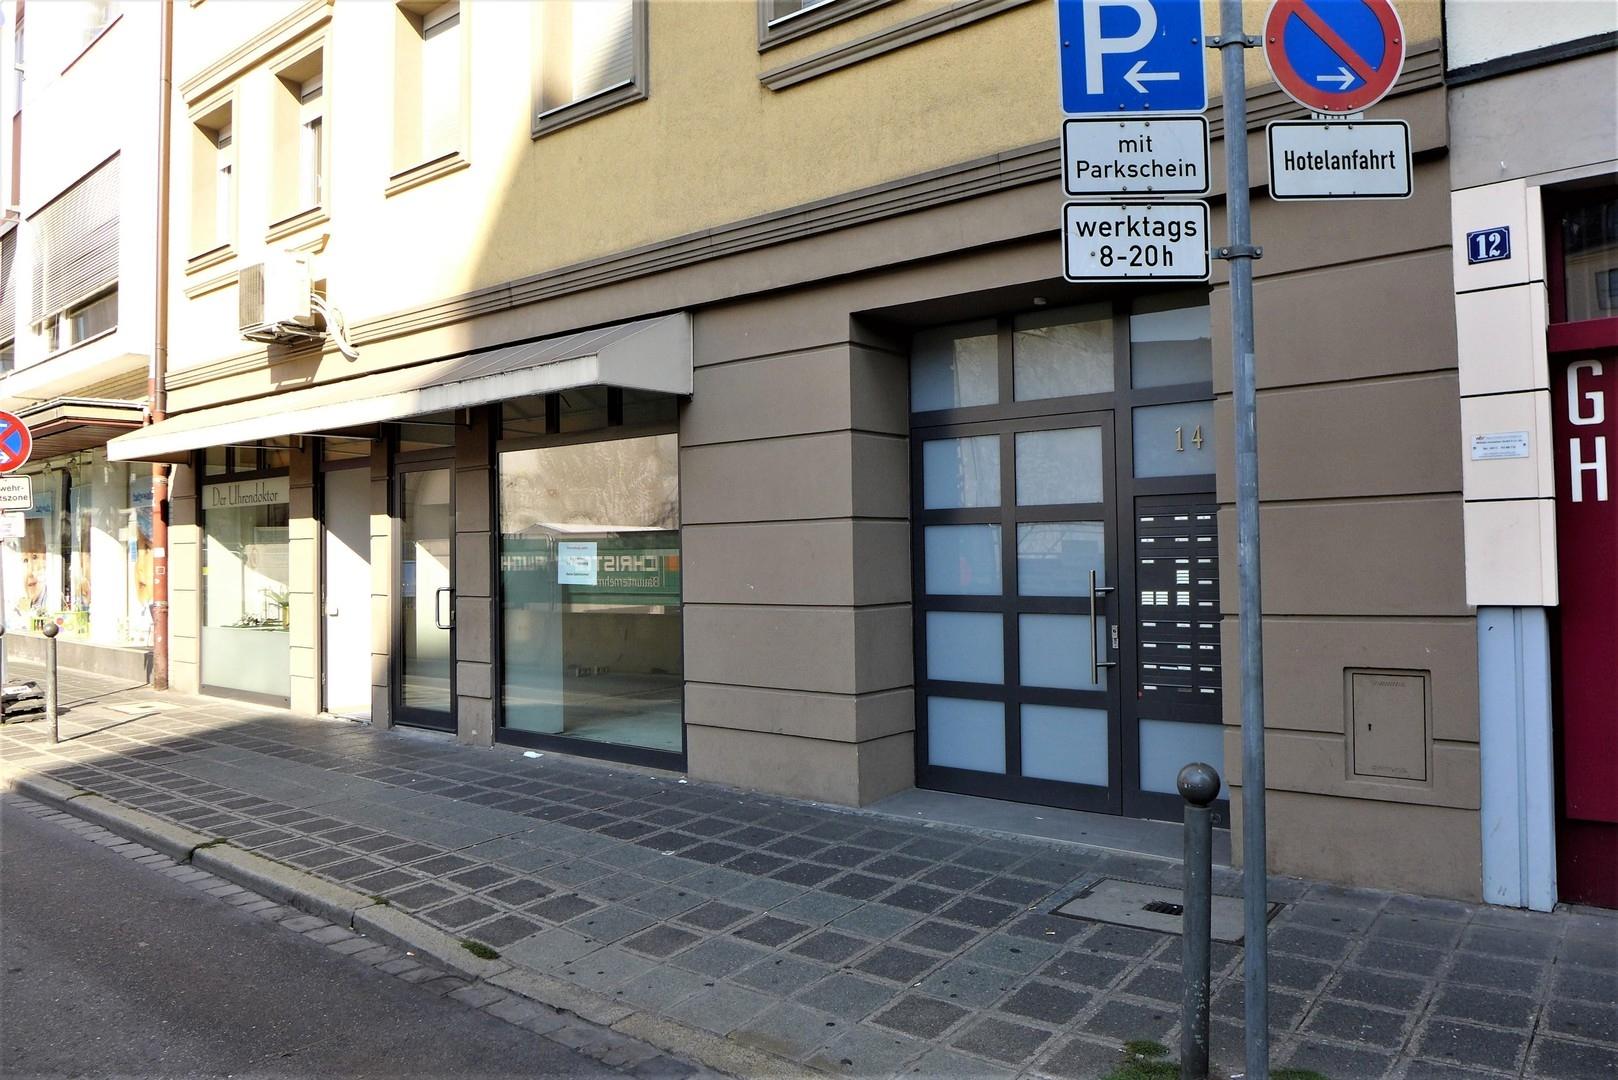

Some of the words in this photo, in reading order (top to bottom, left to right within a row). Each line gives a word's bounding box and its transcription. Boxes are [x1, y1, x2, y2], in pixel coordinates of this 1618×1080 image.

[1083, 0, 1158, 94] P
[1118, 135, 1153, 153] mit
[1076, 159, 1197, 179] Parkschein
[1284, 150, 1396, 171] Hotelanfahrt
[1076, 215, 1198, 242] werktags
[1476, 232, 1501, 258] 12
[1174, 425, 1203, 451] 14
[0, 484, 24, 492] wehr-
[212, 486, 227, 507] Der
[228, 481, 279, 506] Uhrendoktor
